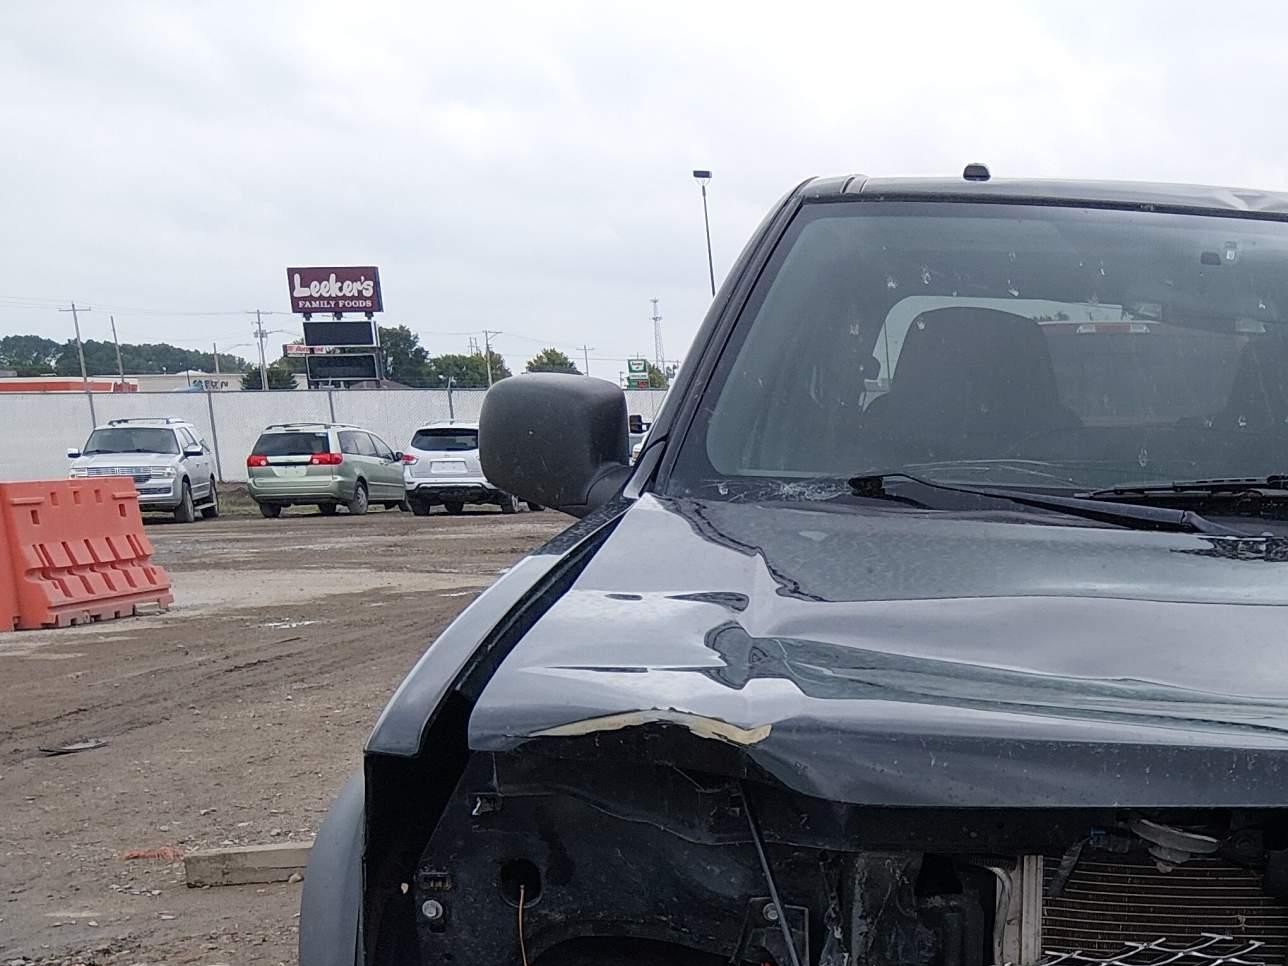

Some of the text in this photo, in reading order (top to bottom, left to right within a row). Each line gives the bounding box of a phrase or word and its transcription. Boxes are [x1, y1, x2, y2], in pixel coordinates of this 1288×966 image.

[293, 273, 374, 297] Leeker's
[298, 300, 373, 308] FAMILY FOODS
